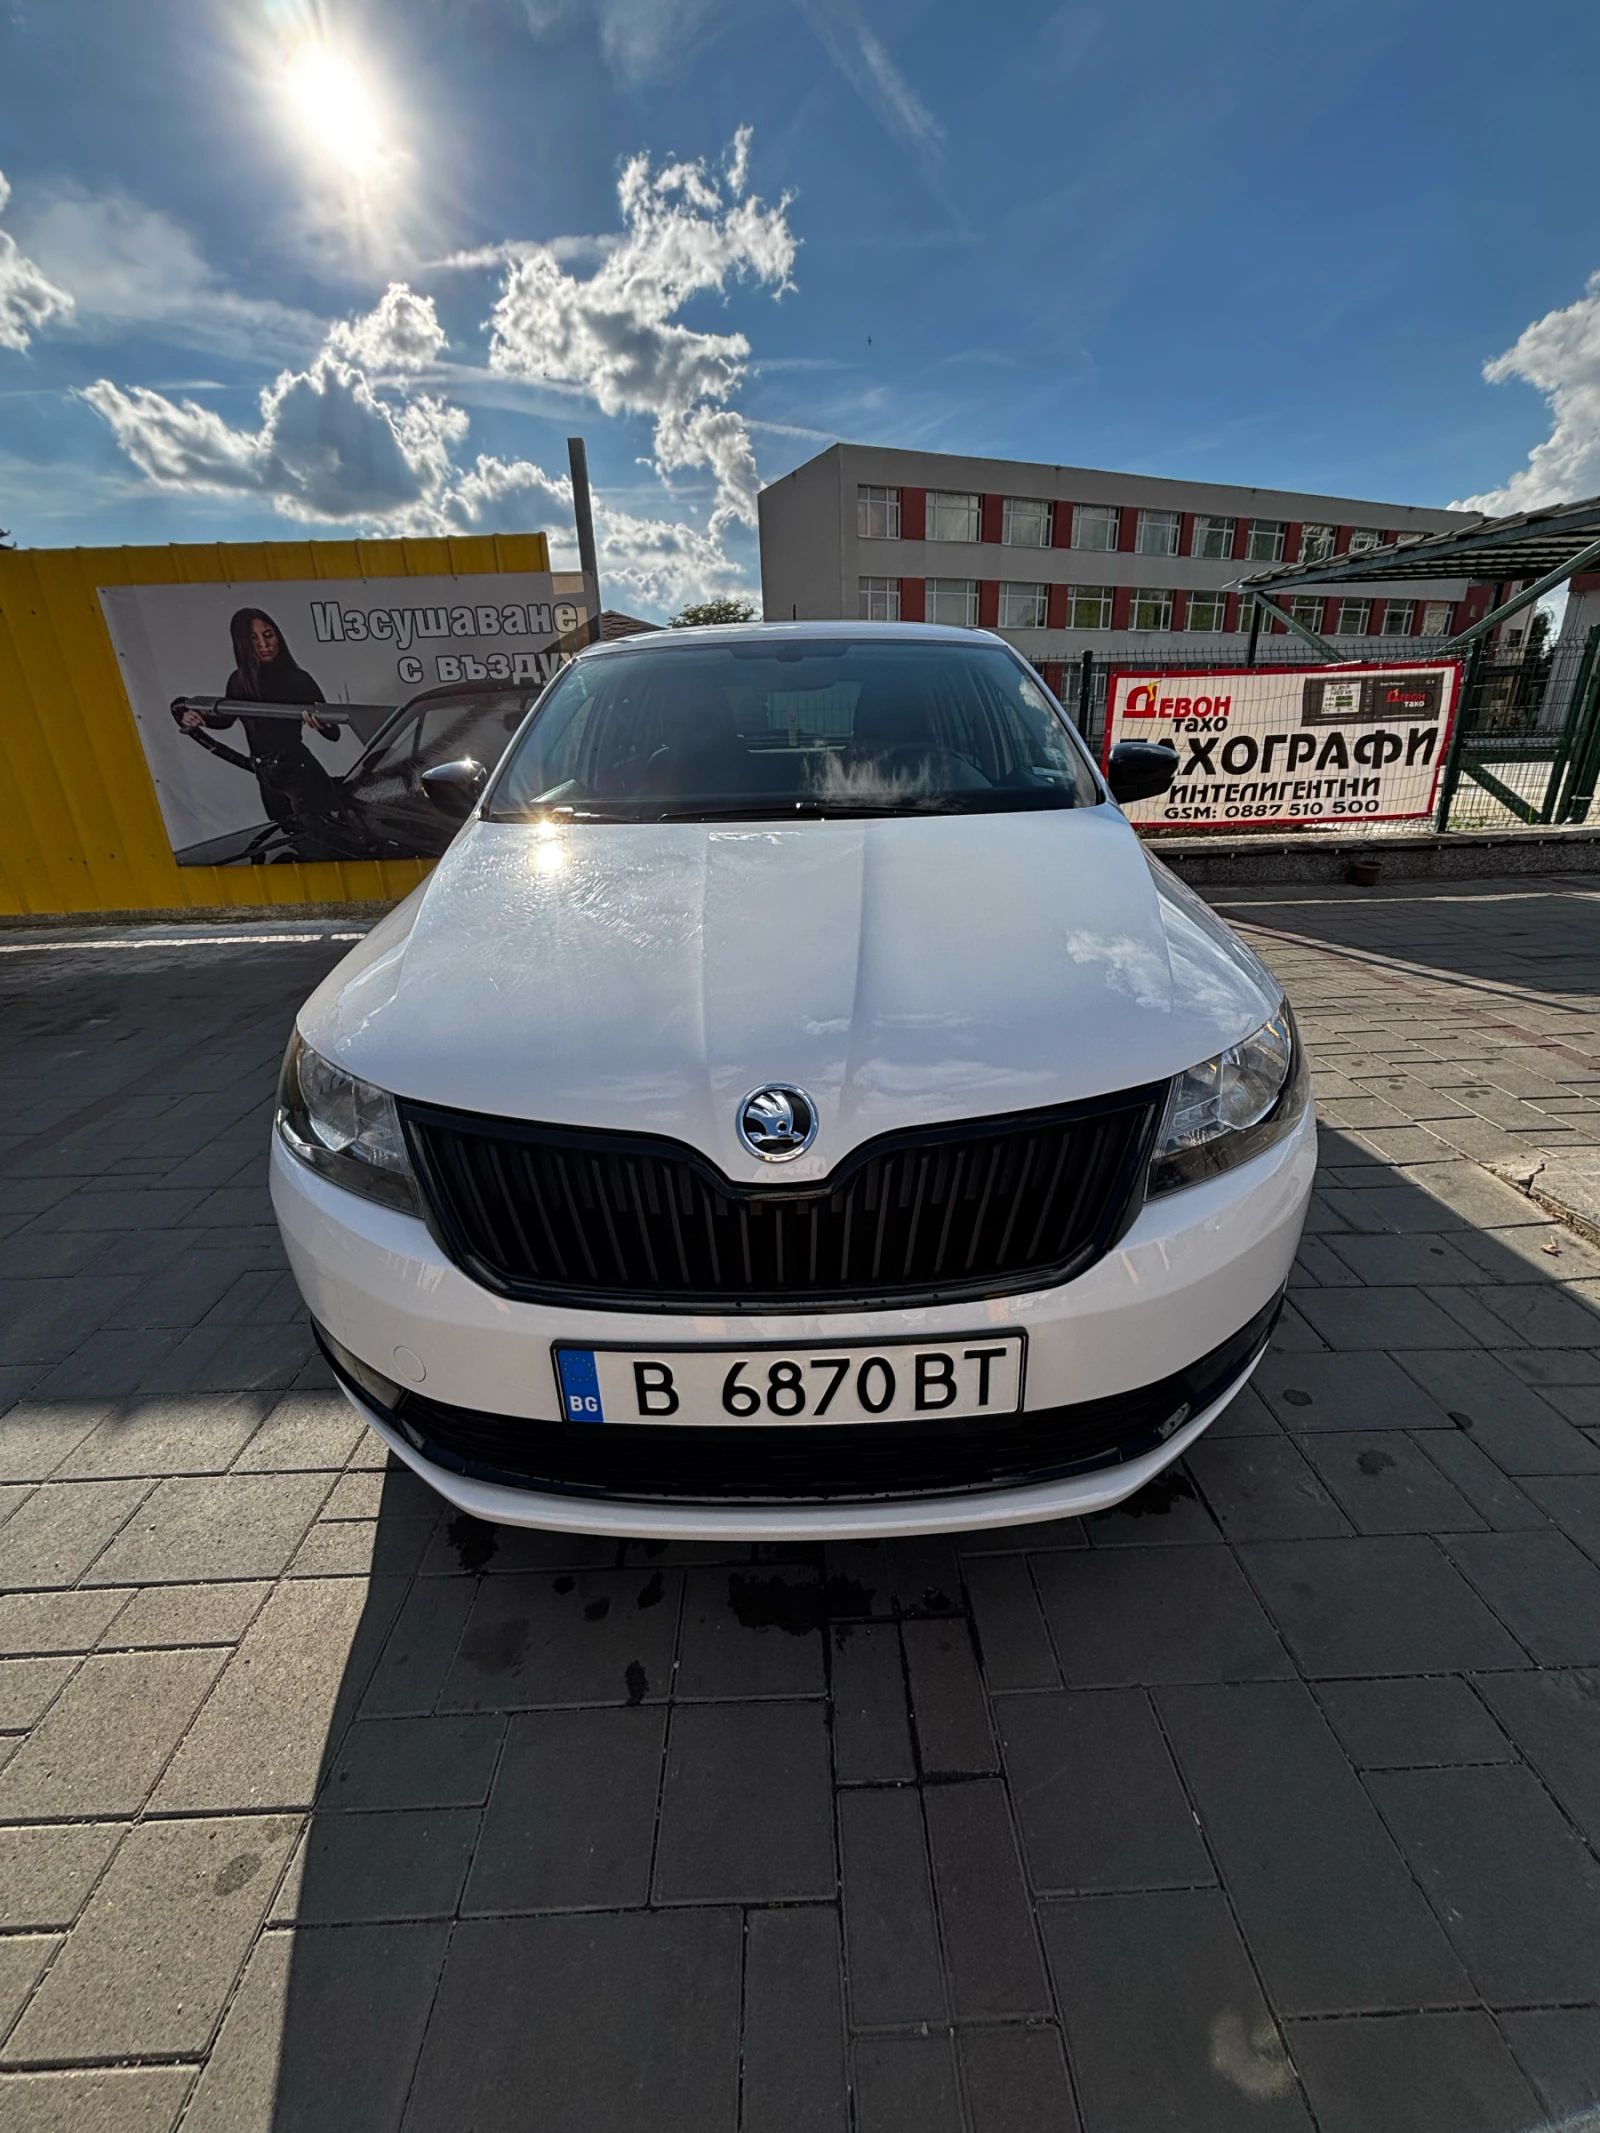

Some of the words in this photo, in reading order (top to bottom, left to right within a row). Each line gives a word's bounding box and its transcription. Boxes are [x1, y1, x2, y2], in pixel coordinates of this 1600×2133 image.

[311, 602, 579, 649] Изсушаване
[398, 654, 424, 684] с
[436, 651, 578, 688] възду
[1122, 683, 1232, 718] ДЕВОН
[1172, 716, 1228, 733] тахо
[1120, 727, 1439, 776] ХОГРАФИ
[1169, 777, 1381, 804] ИНТЕЛИГЕНТНИ
[1164, 806, 1217, 819] GSM:
[1225, 804, 1283, 818] 0887
[1288, 802, 1323, 816] 510
[1332, 799, 1380, 814] 500
[632, 1360, 680, 1416] B
[721, 1356, 896, 1417] 6870
[914, 1347, 1007, 1411] BT
[570, 1395, 599, 1413] BG
